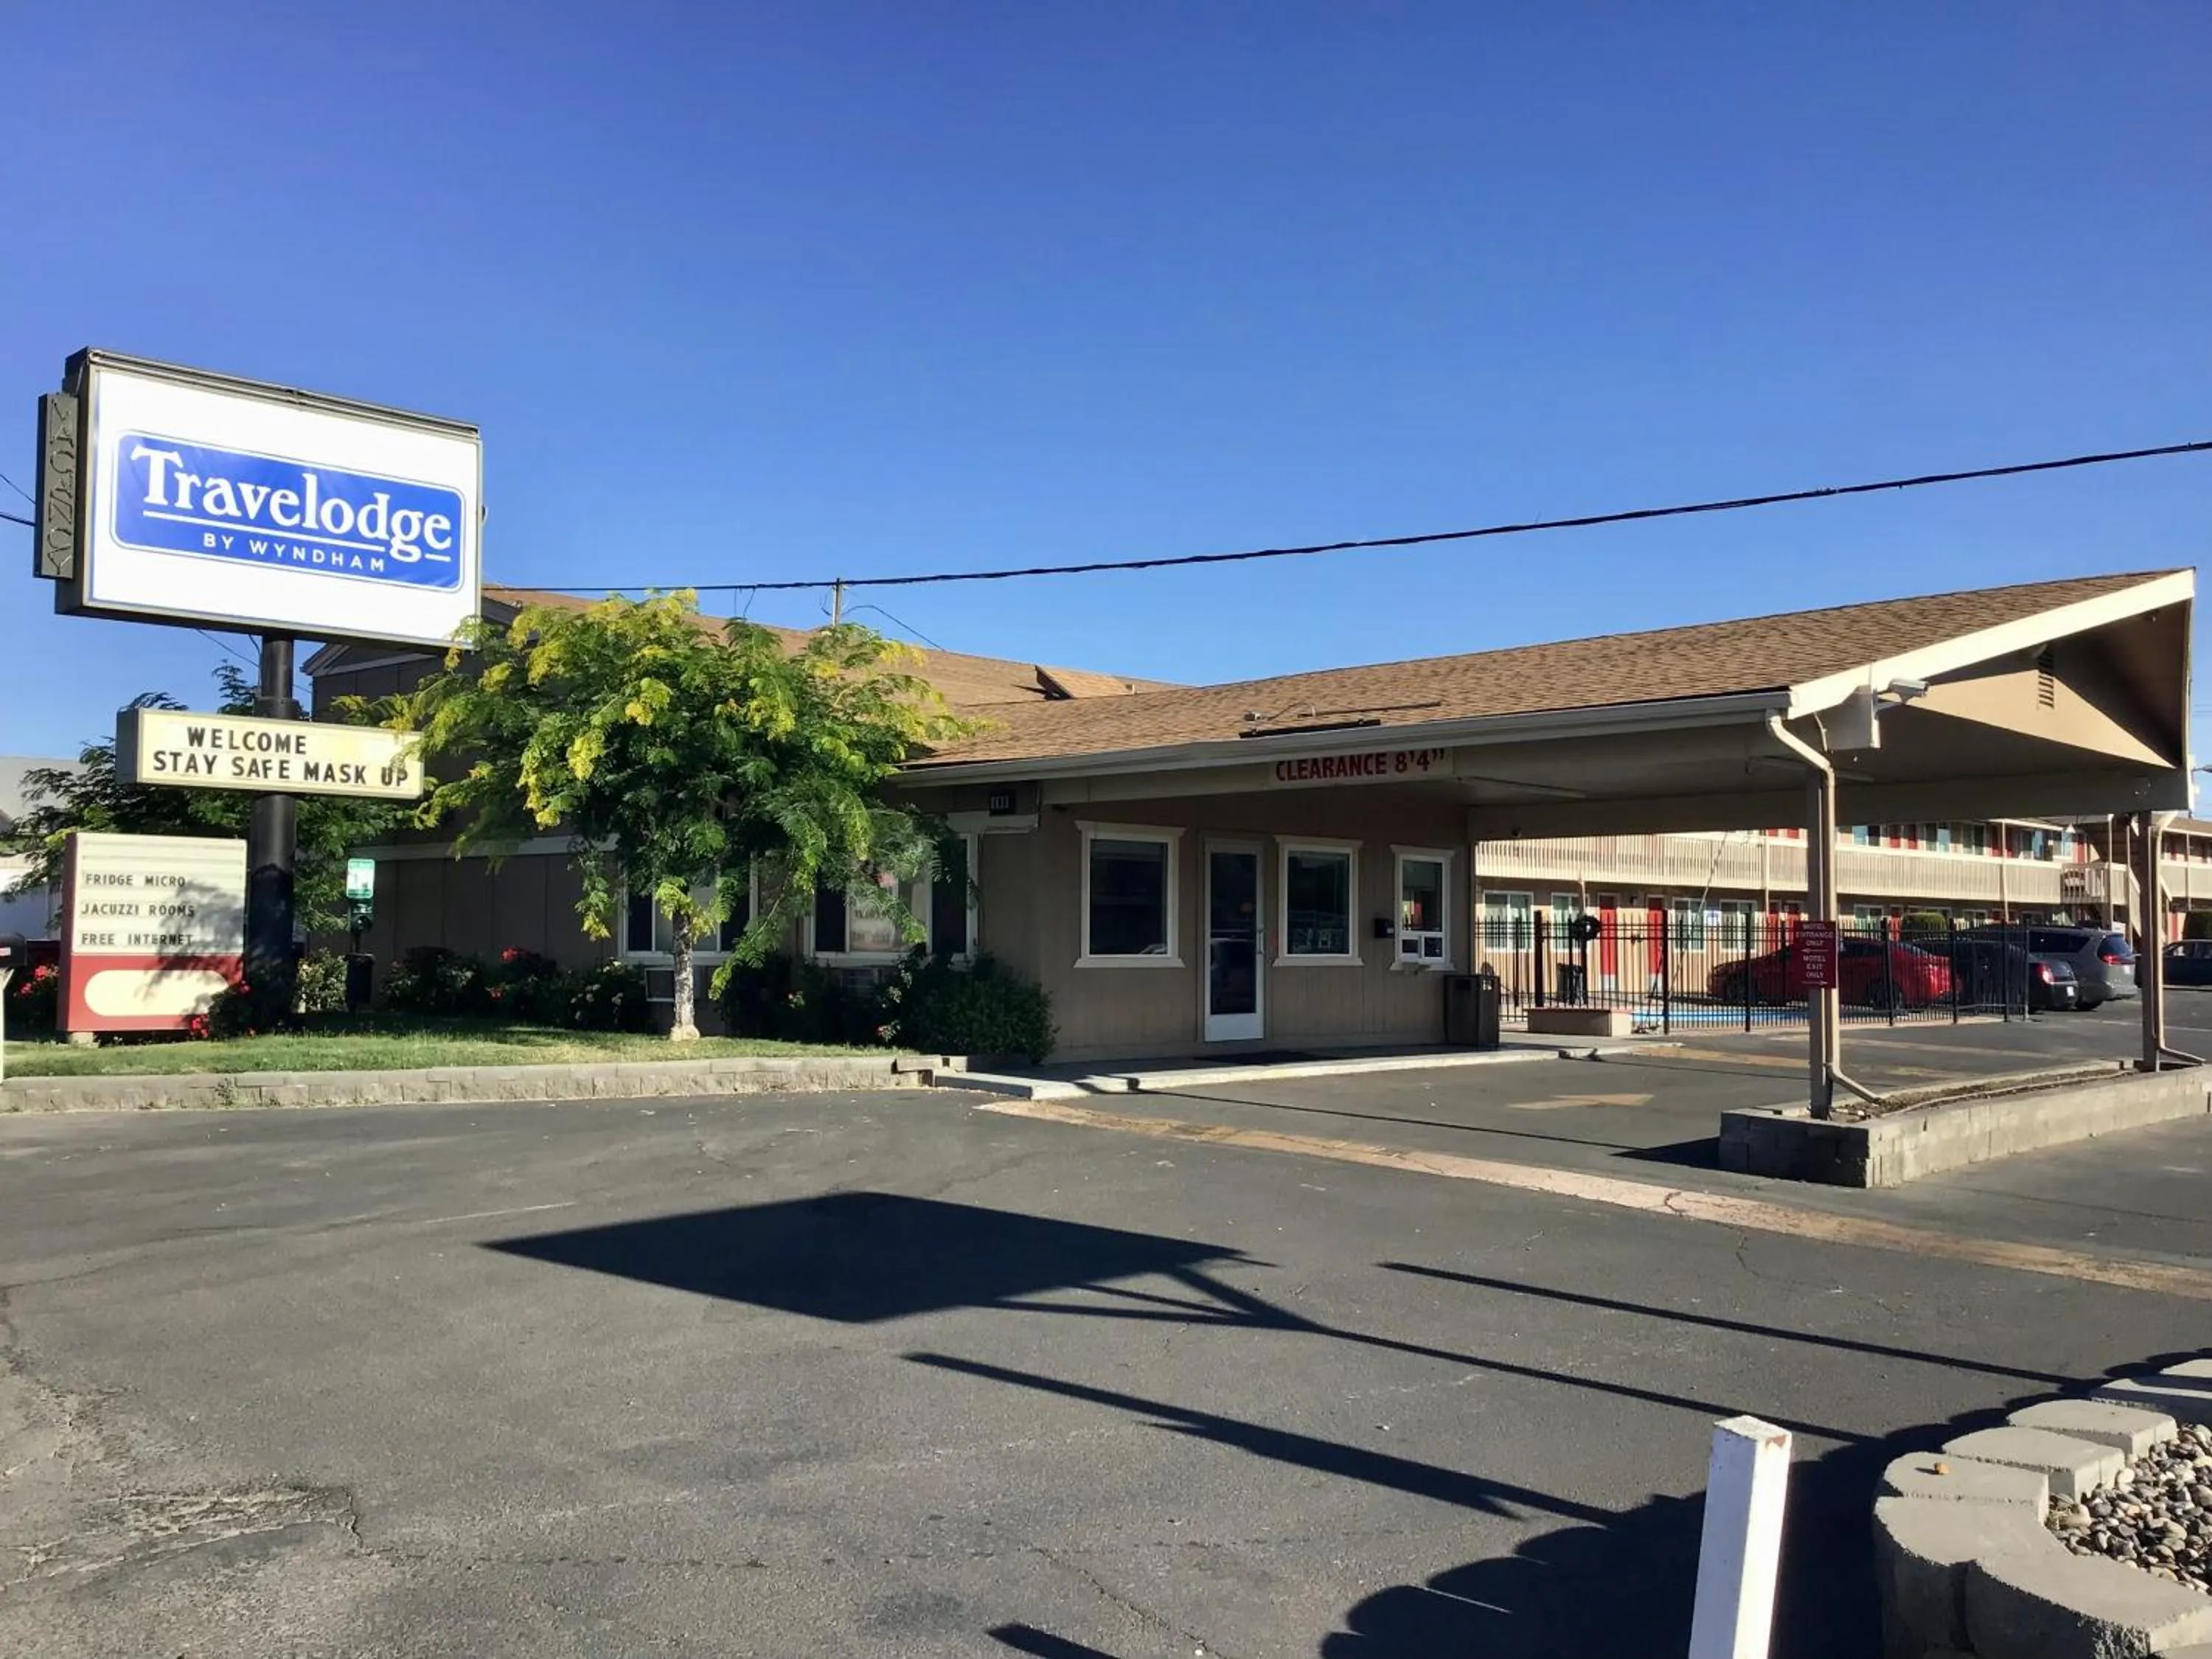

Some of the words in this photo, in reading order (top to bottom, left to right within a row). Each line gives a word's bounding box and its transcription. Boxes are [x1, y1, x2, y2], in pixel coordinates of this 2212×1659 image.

[131, 444, 451, 563] Travelodge
[204, 533, 234, 551] BY
[249, 538, 386, 572] WYNDHAM
[187, 726, 307, 754] WELCOME
[153, 751, 218, 775] STAY
[232, 756, 290, 779] SAFE
[303, 761, 366, 785] MASK
[380, 765, 408, 787] UP
[1276, 752, 1387, 782] CLEARANCE
[86, 873, 134, 886] FRIDGE
[144, 875, 186, 887] MICRO
[81, 903, 140, 916] JACUZZI
[148, 905, 195, 917] ROOMS
[81, 933, 116, 945] FREE
[128, 933, 193, 945] INTERNET
